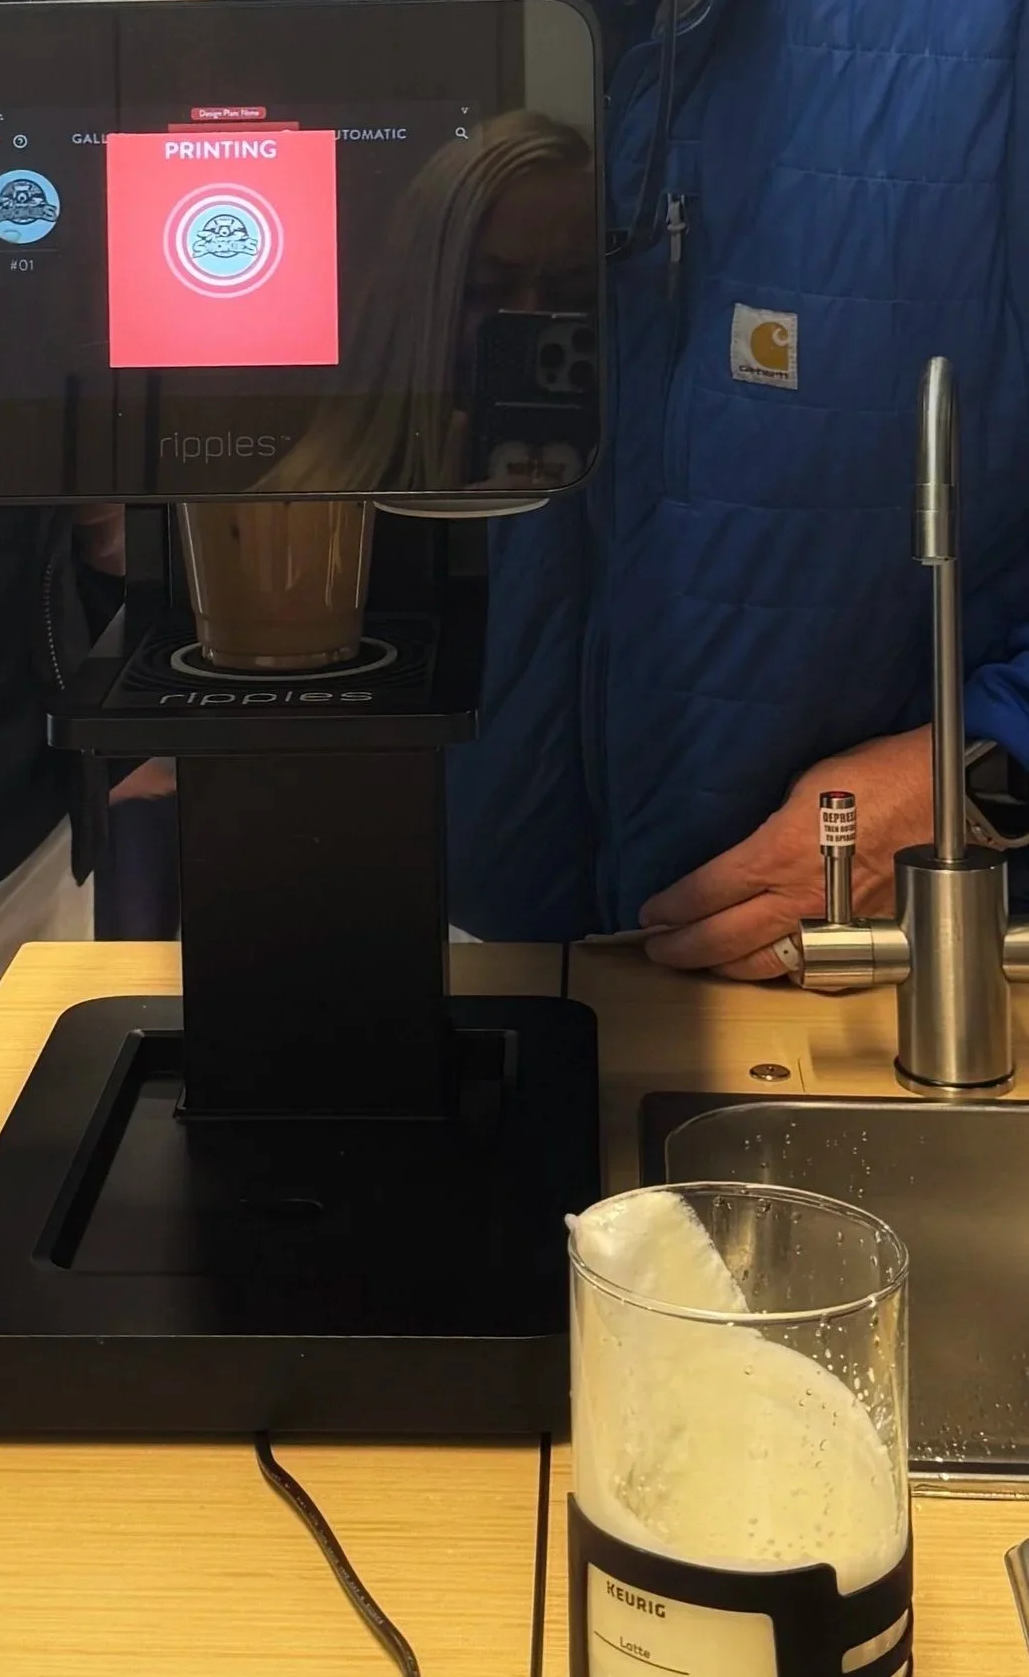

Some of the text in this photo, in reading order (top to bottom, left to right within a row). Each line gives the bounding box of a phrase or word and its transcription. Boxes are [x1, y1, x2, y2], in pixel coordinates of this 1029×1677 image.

[165, 139, 278, 160] PRINTING
[10, 259, 35, 272] #01
[160, 690, 372, 706] ripples
[606, 1580, 666, 1619] KEURIG
[619, 1635, 651, 1659] Latte
